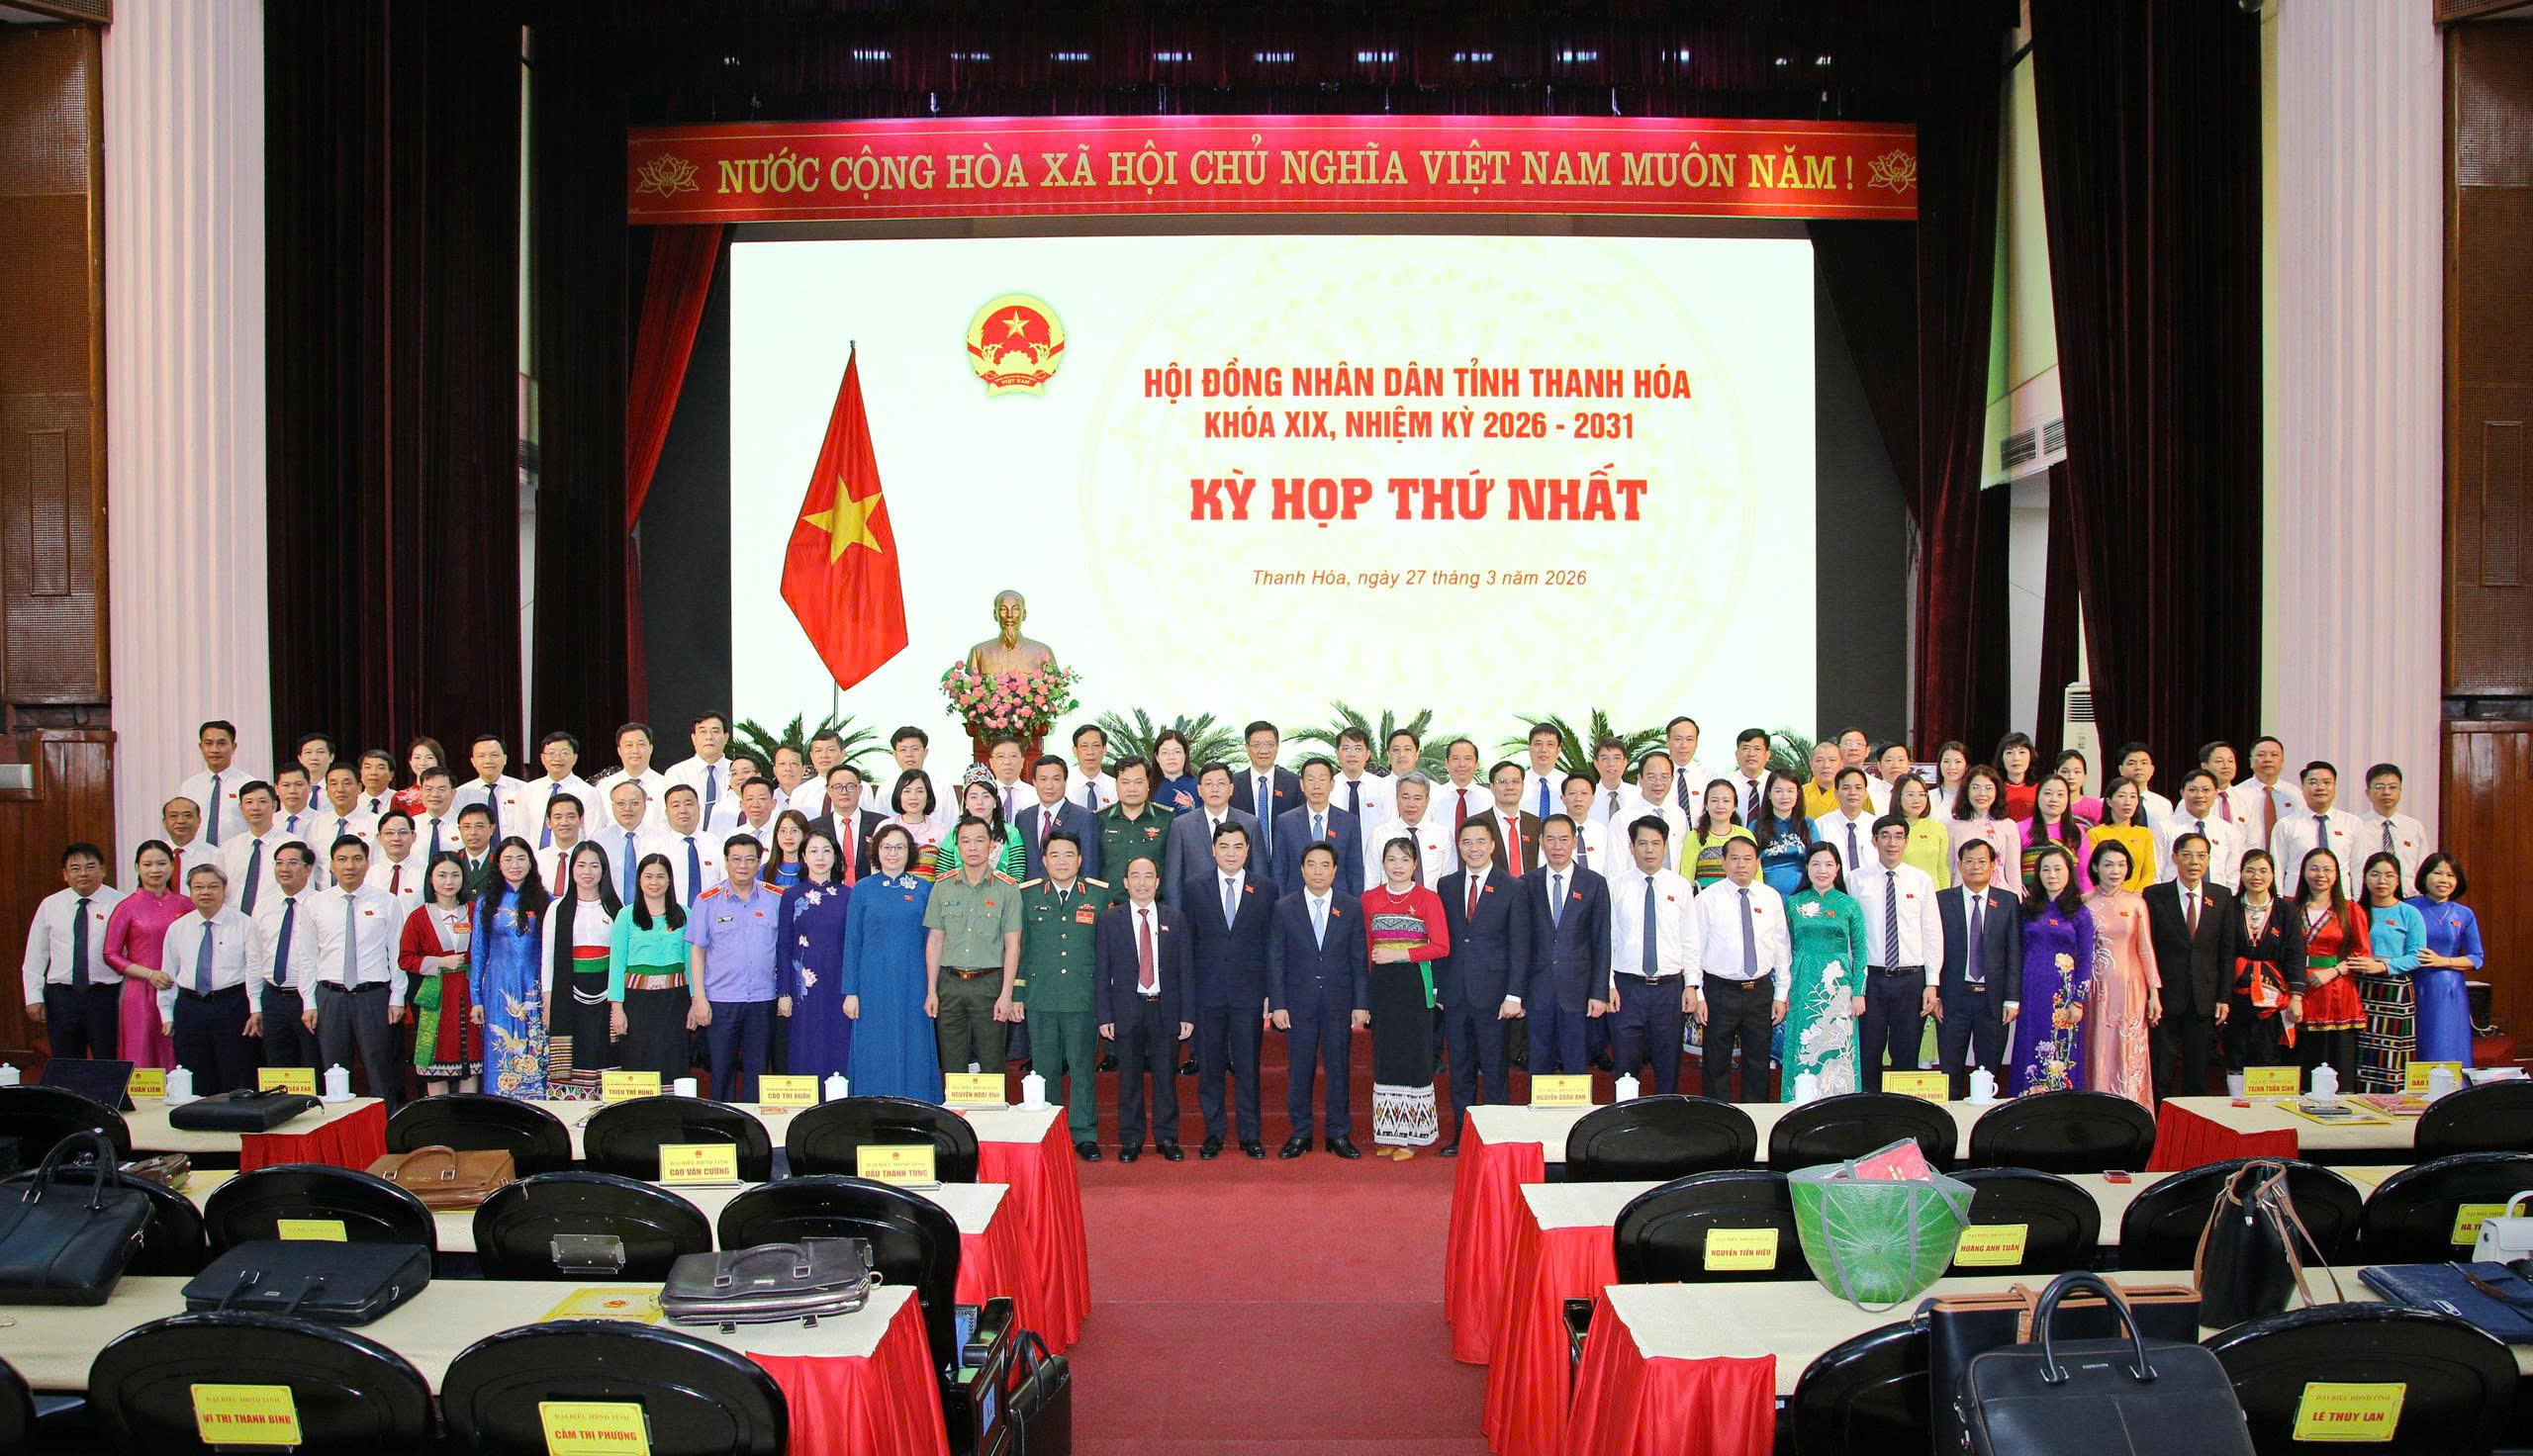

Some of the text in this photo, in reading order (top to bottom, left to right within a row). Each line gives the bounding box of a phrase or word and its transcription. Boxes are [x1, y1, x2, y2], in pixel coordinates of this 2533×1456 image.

[718, 146, 820, 195] NƯỚC
[830, 145, 936, 201] CỘNG
[947, 142, 1029, 190] HÒA
[1041, 143, 1097, 188] XÃ
[1108, 139, 1178, 196] HỘI
[1190, 134, 1267, 187] CHỦ
[1281, 142, 1408, 186] NGHĨA
[1420, 138, 1512, 195] VIỆT
[1522, 151, 1612, 187] NAM
[1622, 141, 1738, 189] MUÔN
[1145, 357, 1693, 405] HỘI ĐỒNG NHÂN DÂN TỈNH THANH HÓA
[1205, 407, 1276, 439] KHÓA
[1285, 411, 1337, 442] XIX,
[1346, 407, 1434, 444] NHIỆM
[1443, 406, 1475, 439] KỲ
[1484, 411, 1548, 439] 2026
[1575, 412, 1635, 440] 2031
[1190, 463, 1648, 529] KỲ HỌP THỨ NHẤT
[1253, 569, 1588, 590] Thanh Hóa, ngày 27 tháng 3 năm 2026
[669, 1168, 685, 1177] CAO
[235, 1414, 266, 1424] THANH
[2362, 1411, 2386, 1422] LAN
[578, 1430, 596, 1442] THỊ
